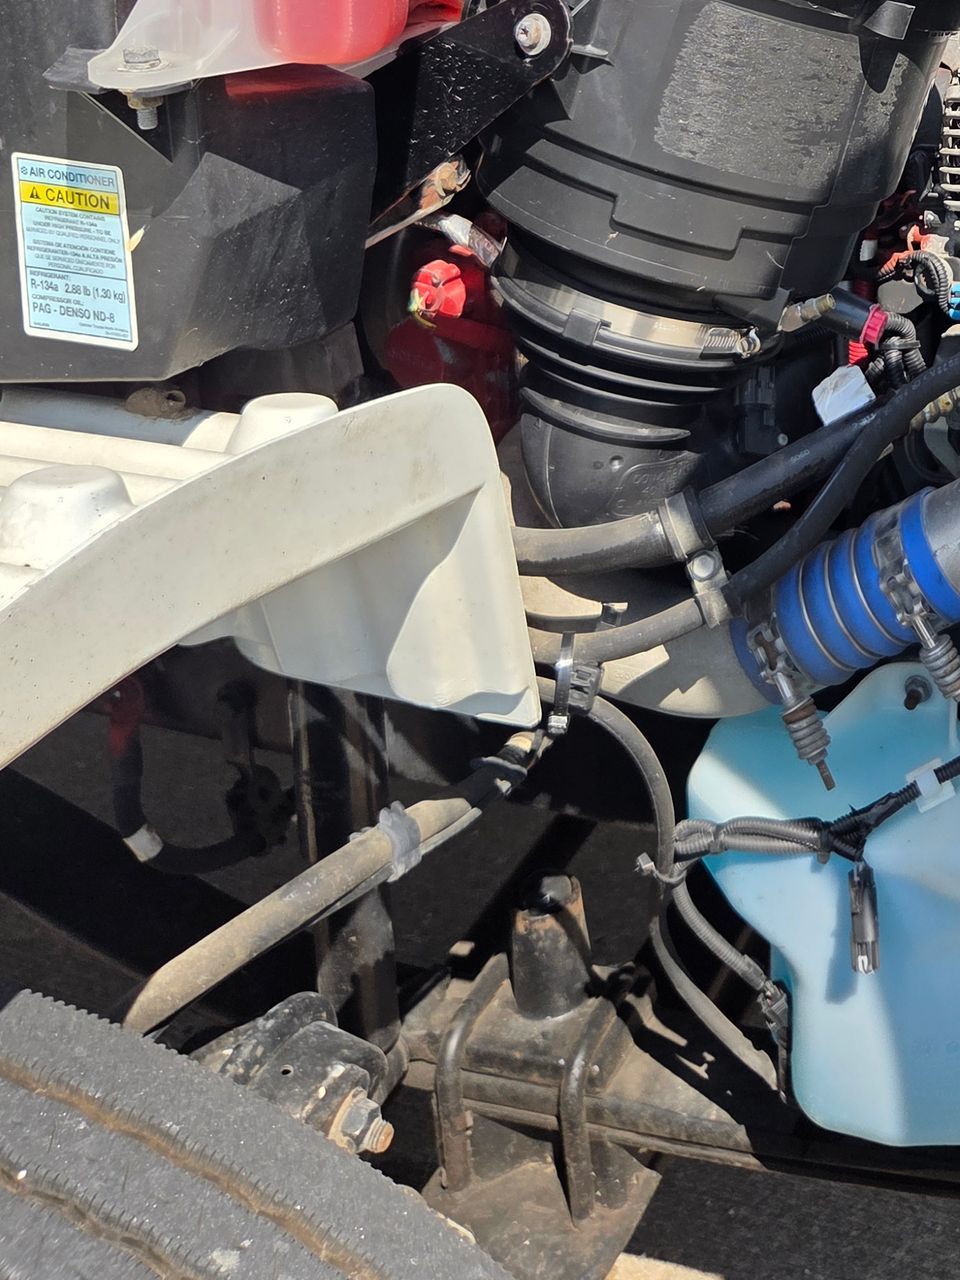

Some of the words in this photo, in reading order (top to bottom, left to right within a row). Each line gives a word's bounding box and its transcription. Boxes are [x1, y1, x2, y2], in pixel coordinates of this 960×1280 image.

[29, 166, 46, 178] AIR
[47, 168, 114, 187] CONDITIONER
[45, 188, 110, 209] CAUTION
[30, 270, 71, 280] REFRIGERANT:
[31, 278, 59, 292] R-134a
[64, 284, 82, 295] 2.88
[83, 286, 90, 296] lb
[93, 287, 111, 300] (1.30
[113, 291, 126, 304] kg)
[32, 294, 72, 304] COMPRESSOR
[33, 302, 52, 314] PAG
[59, 305, 90, 319] DENSO
[93, 311, 115, 323] ND-8
